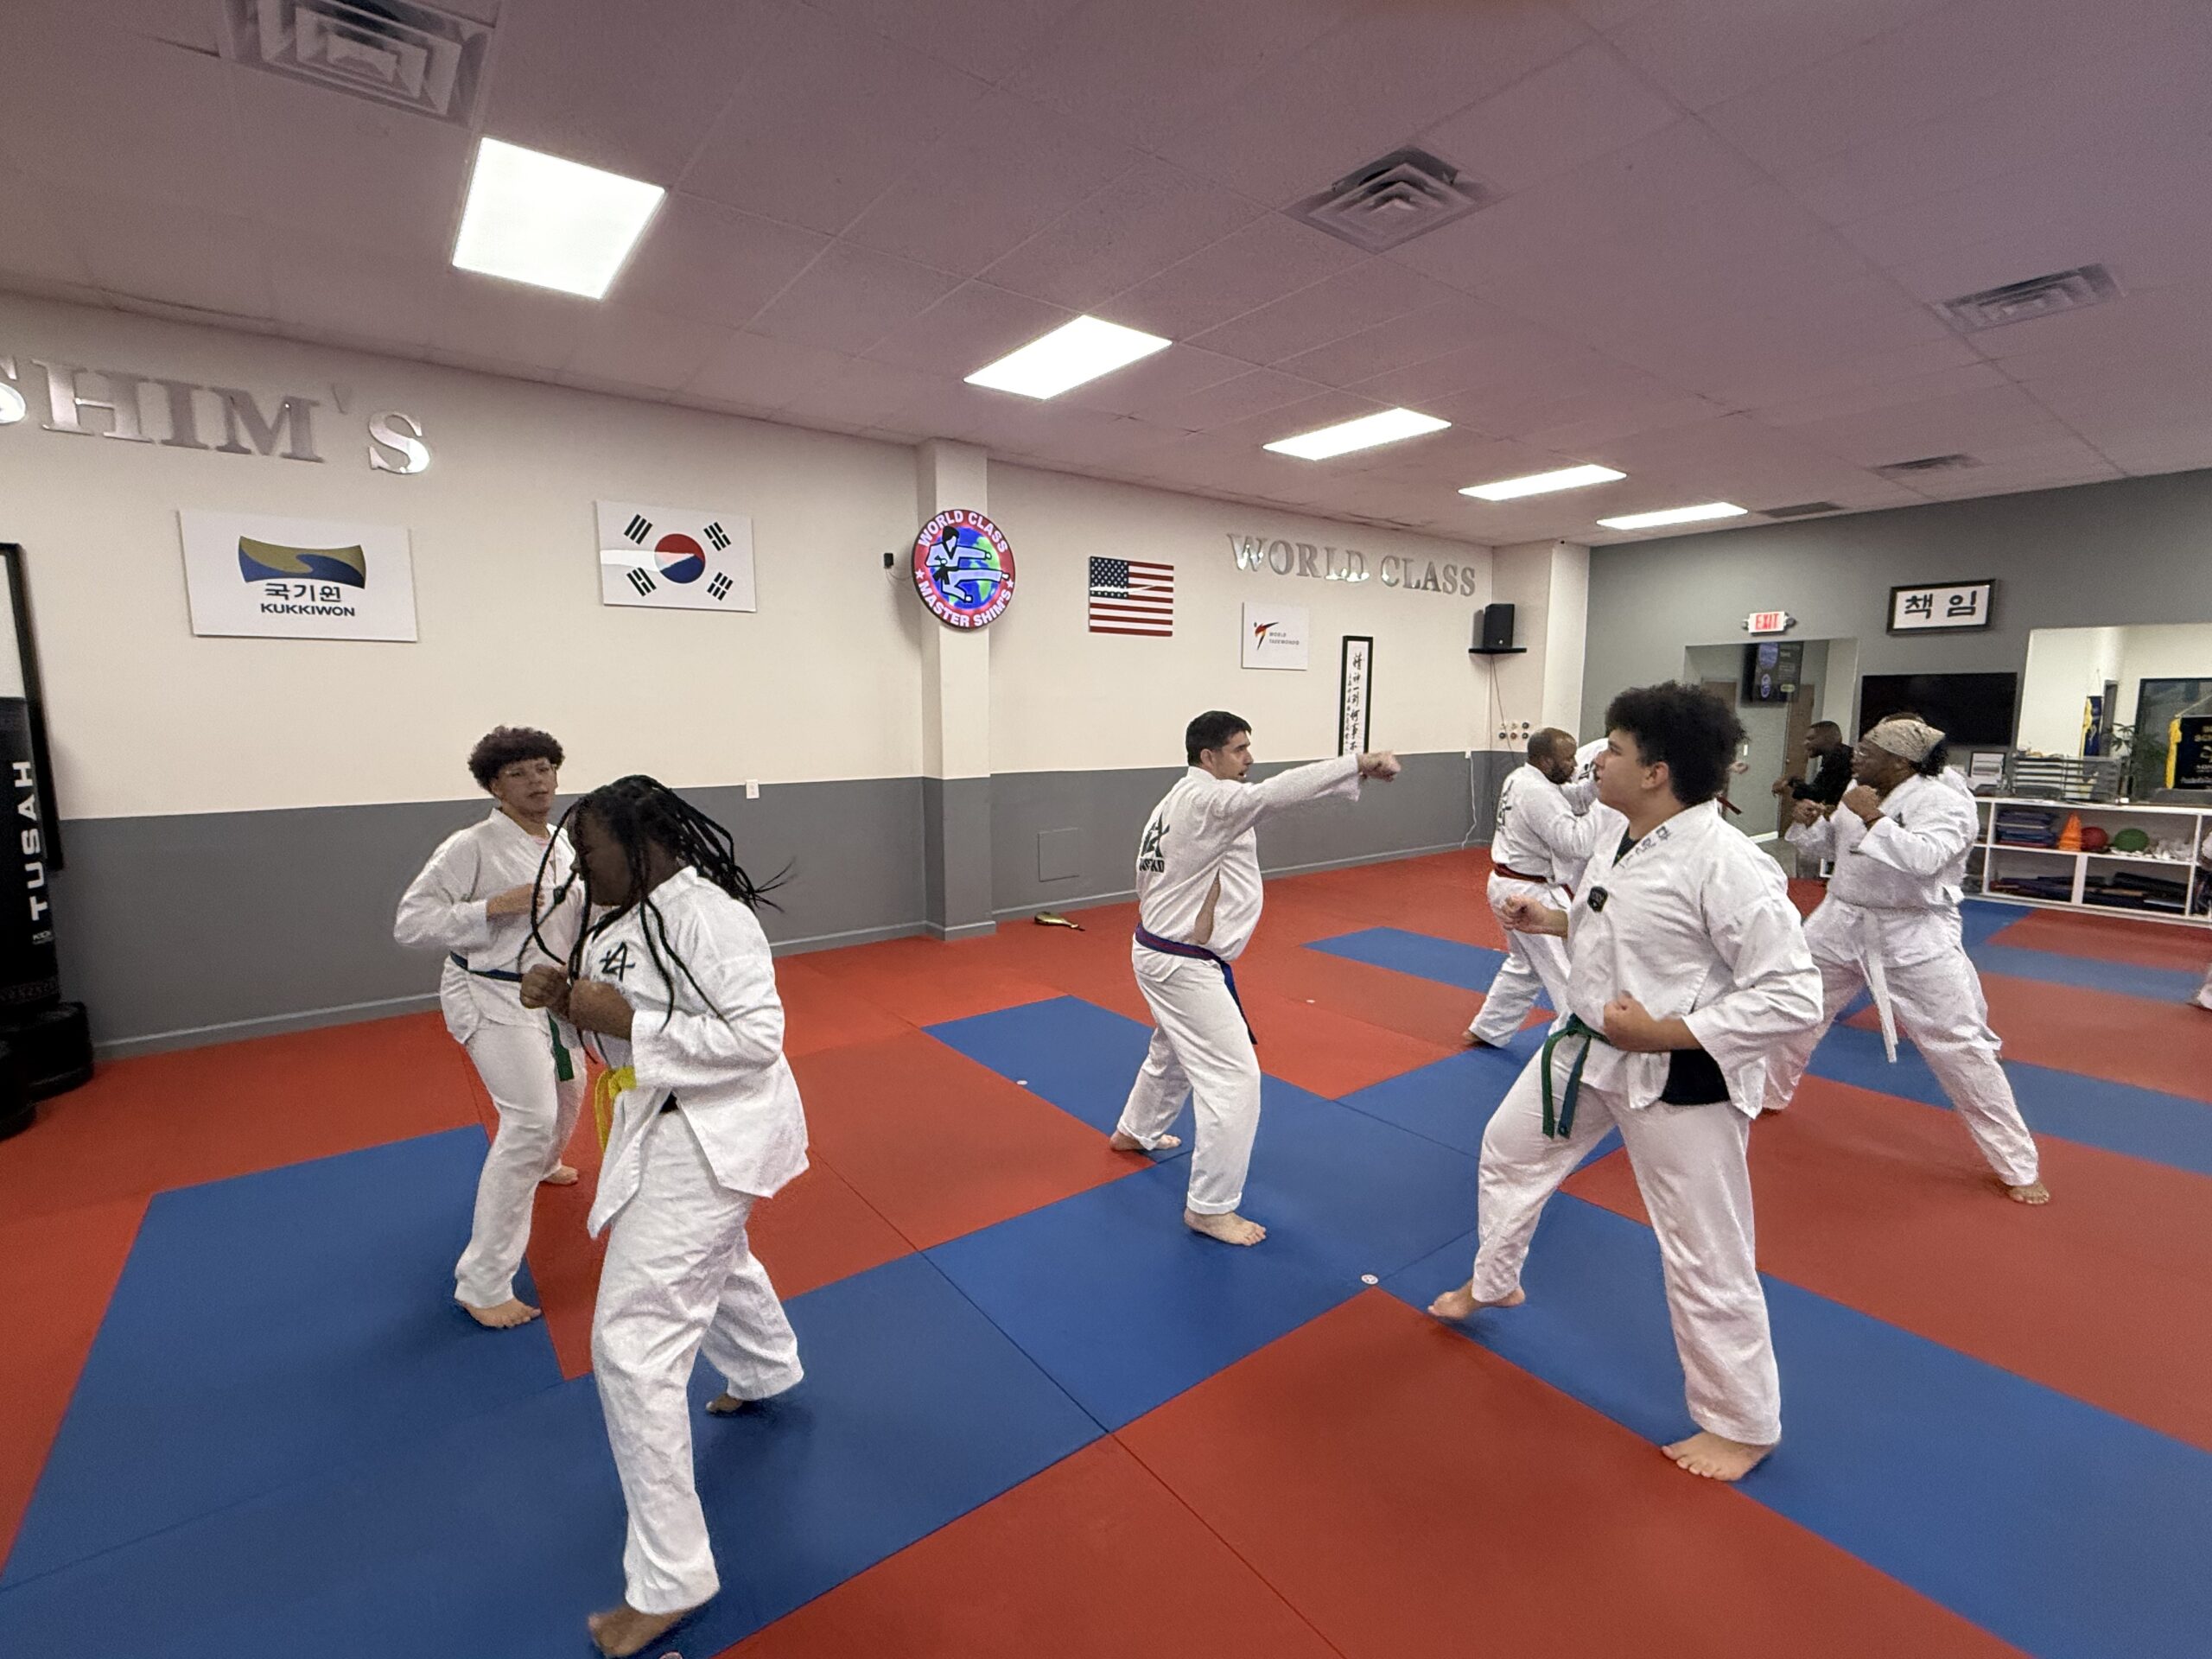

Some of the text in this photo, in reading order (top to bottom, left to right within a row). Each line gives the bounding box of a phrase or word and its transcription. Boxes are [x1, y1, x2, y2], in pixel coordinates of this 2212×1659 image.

[918, 510, 1008, 553] WORLD CLASS
[1226, 533, 1477, 597] WORLD CLASS
[260, 603, 355, 617] KUKKIWON
[264, 582, 342, 602] 국기원
[918, 580, 1012, 627] MASTER SHIM'S
[1755, 613, 1780, 631] EXIT
[12, 761, 48, 921] TUSAH
